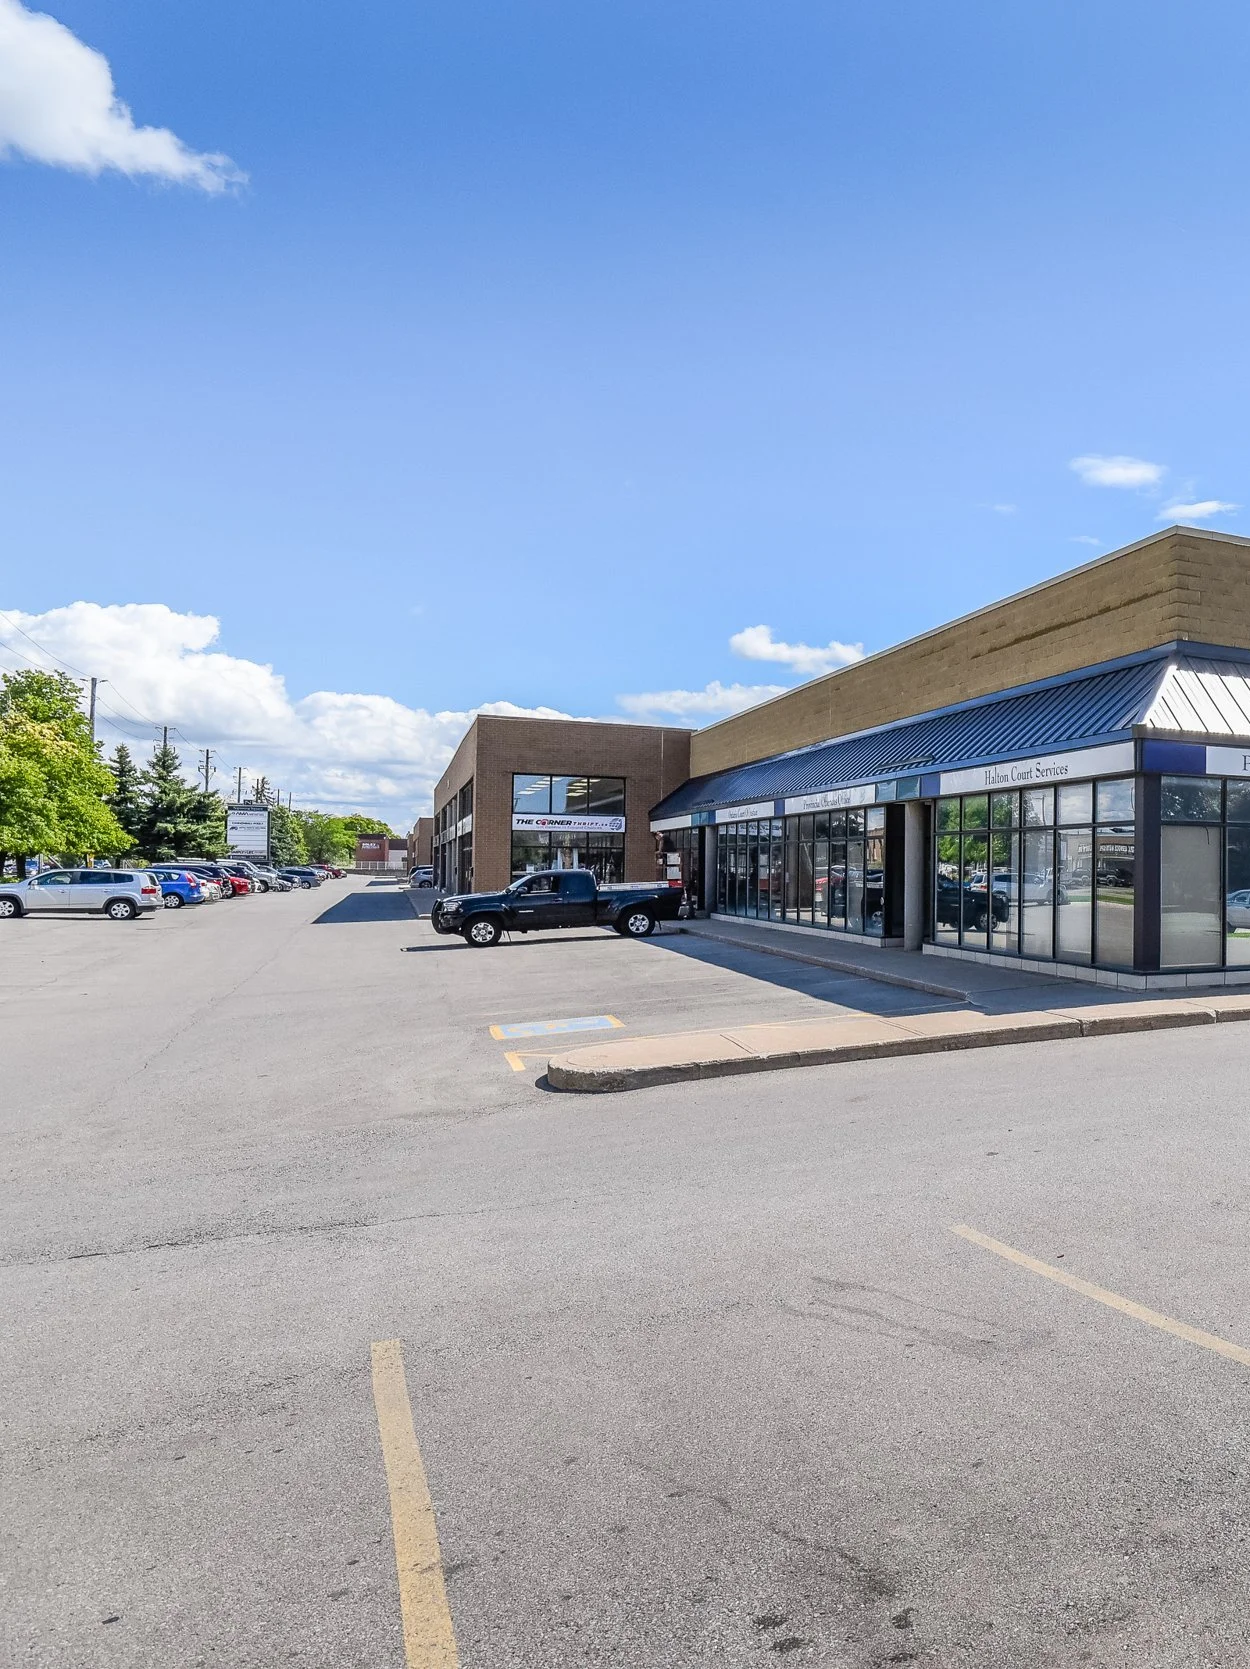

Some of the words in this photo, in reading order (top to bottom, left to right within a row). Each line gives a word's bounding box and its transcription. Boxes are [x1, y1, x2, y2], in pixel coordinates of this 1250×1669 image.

[984, 767, 1009, 785] Halton
[1011, 766, 1032, 782] Court
[1035, 762, 1068, 778] Services
